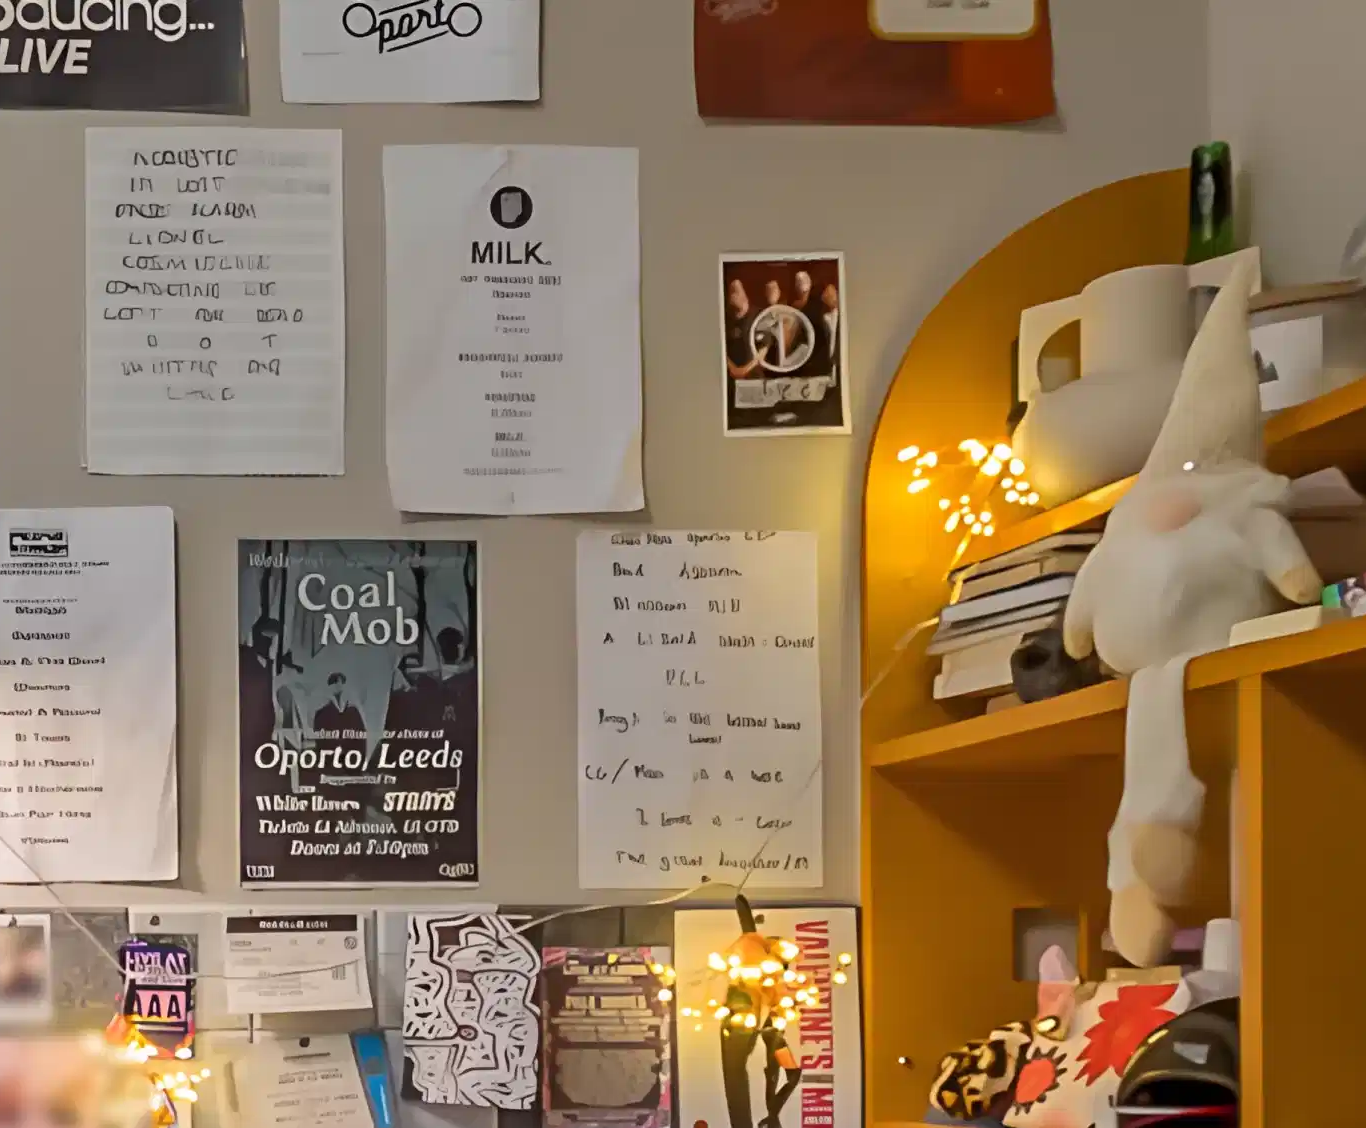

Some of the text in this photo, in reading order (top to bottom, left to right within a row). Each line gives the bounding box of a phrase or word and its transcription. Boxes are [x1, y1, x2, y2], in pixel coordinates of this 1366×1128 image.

[297, 570, 396, 611] Coal
[320, 606, 420, 646] Mob
[377, 740, 464, 769] Leeds
